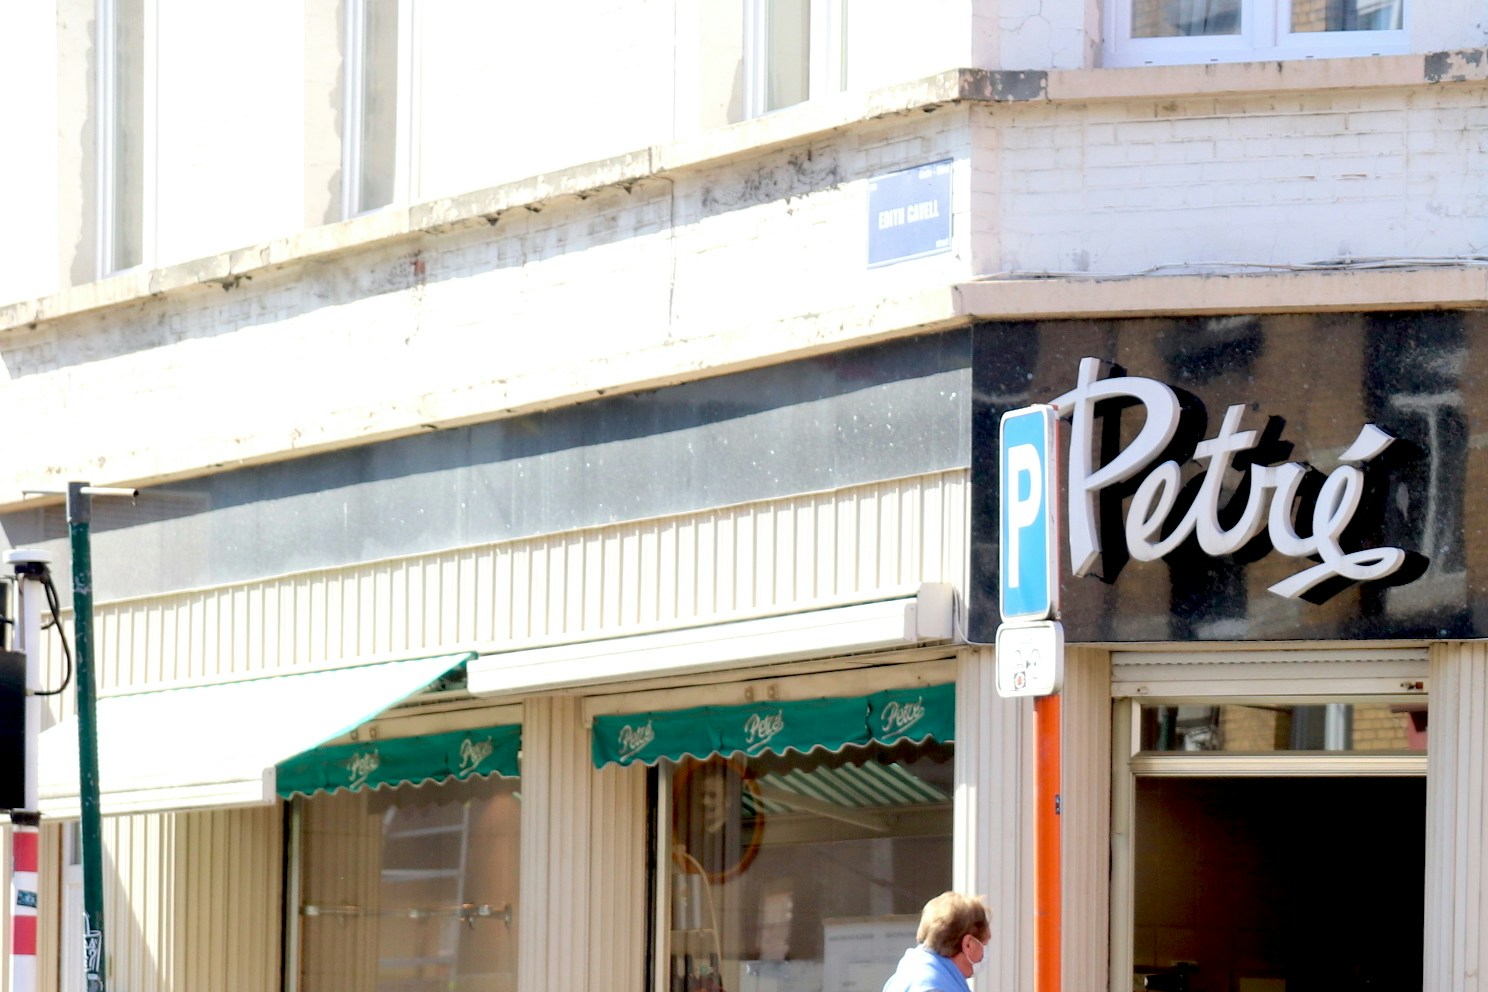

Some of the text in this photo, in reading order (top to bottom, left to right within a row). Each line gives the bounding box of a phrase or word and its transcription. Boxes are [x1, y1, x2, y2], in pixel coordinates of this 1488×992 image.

[878, 200, 940, 230] EDITH CAVELL
[1007, 443, 1043, 589] P
[1048, 356, 1405, 599] Petré
